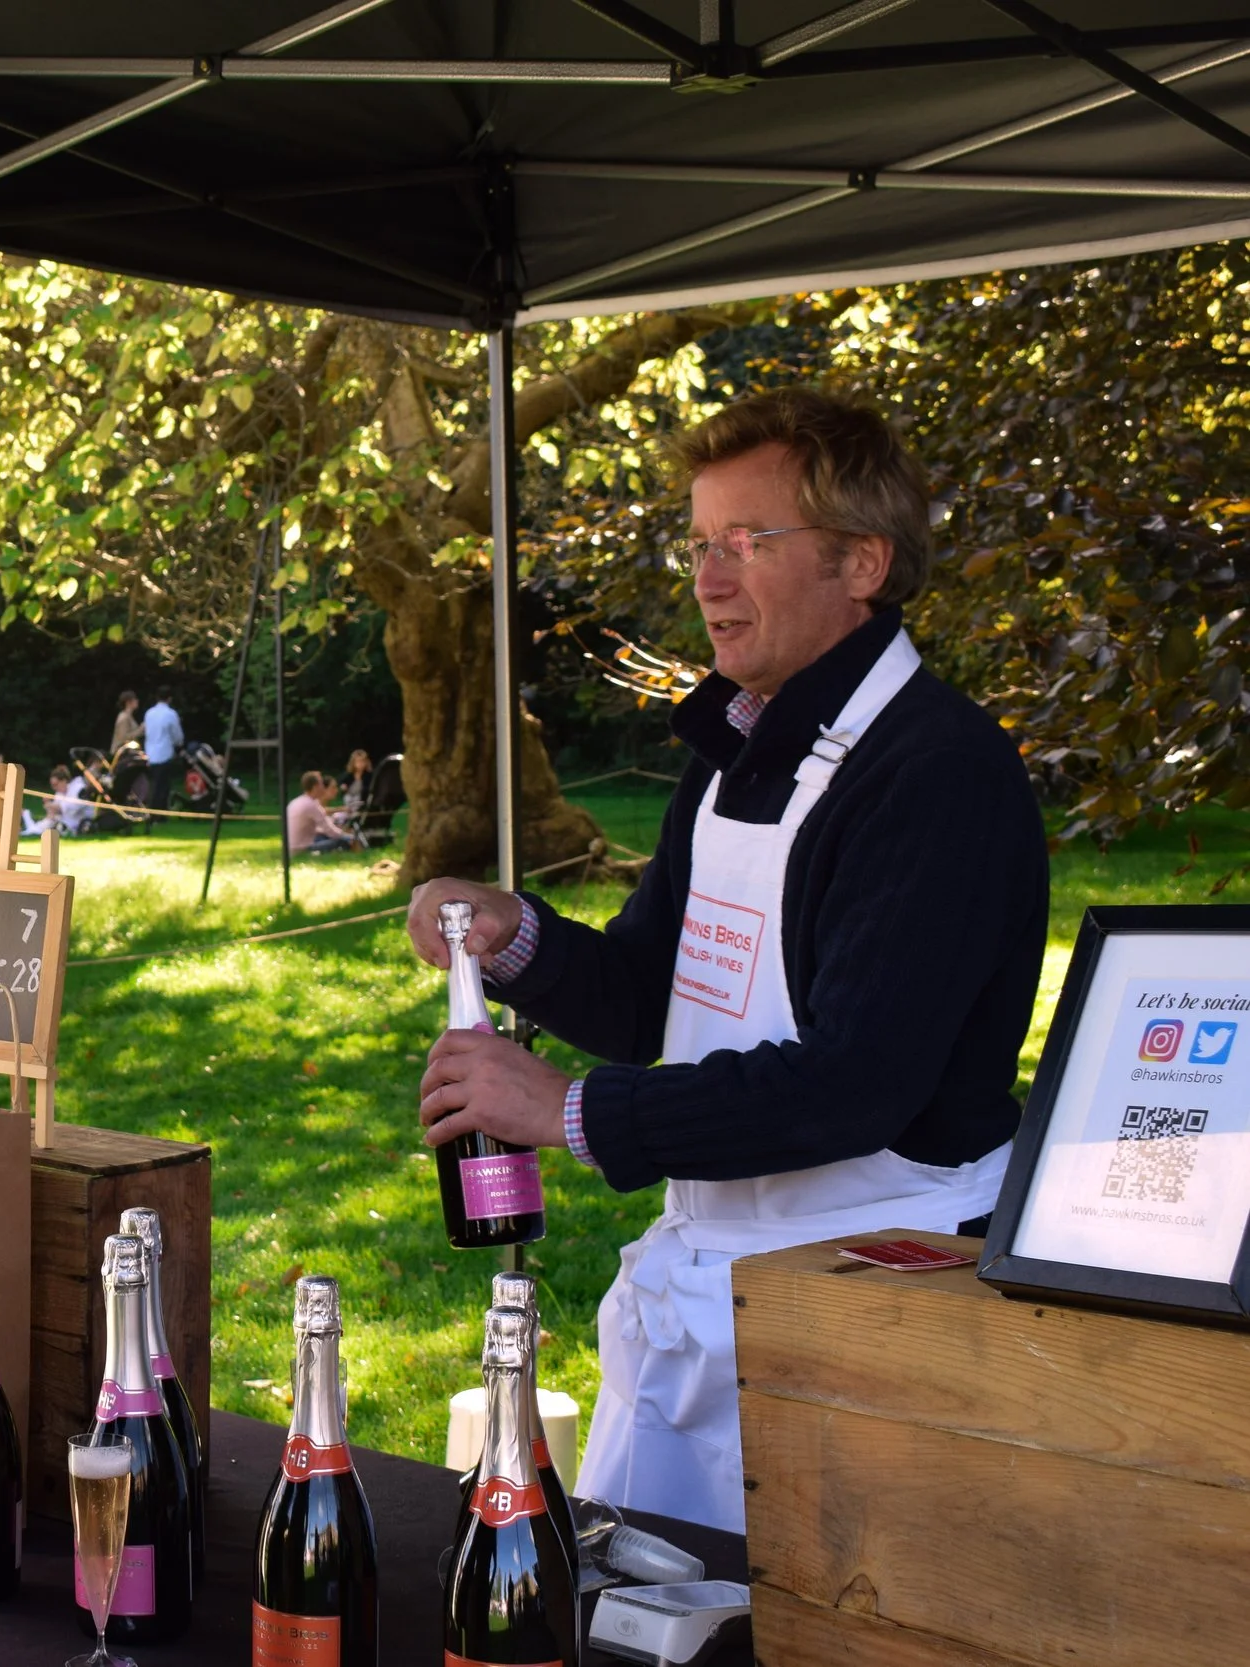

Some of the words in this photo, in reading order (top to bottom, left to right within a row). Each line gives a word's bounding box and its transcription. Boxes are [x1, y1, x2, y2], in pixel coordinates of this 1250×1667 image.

[20, 908, 38, 944] 7
[714, 923, 753, 953] BROS.
[10, 957, 42, 994] 28
[716, 954, 744, 974] WINES
[1136, 992, 1177, 1010] Let's
[1178, 992, 1200, 1010] be
[1131, 1067, 1223, 1085] @hawkinsbros
[1070, 1204, 1207, 1228] www.hawkinsbros.co.uk
[285, 1446, 310, 1469] HB
[484, 1491, 512, 1512] HB
